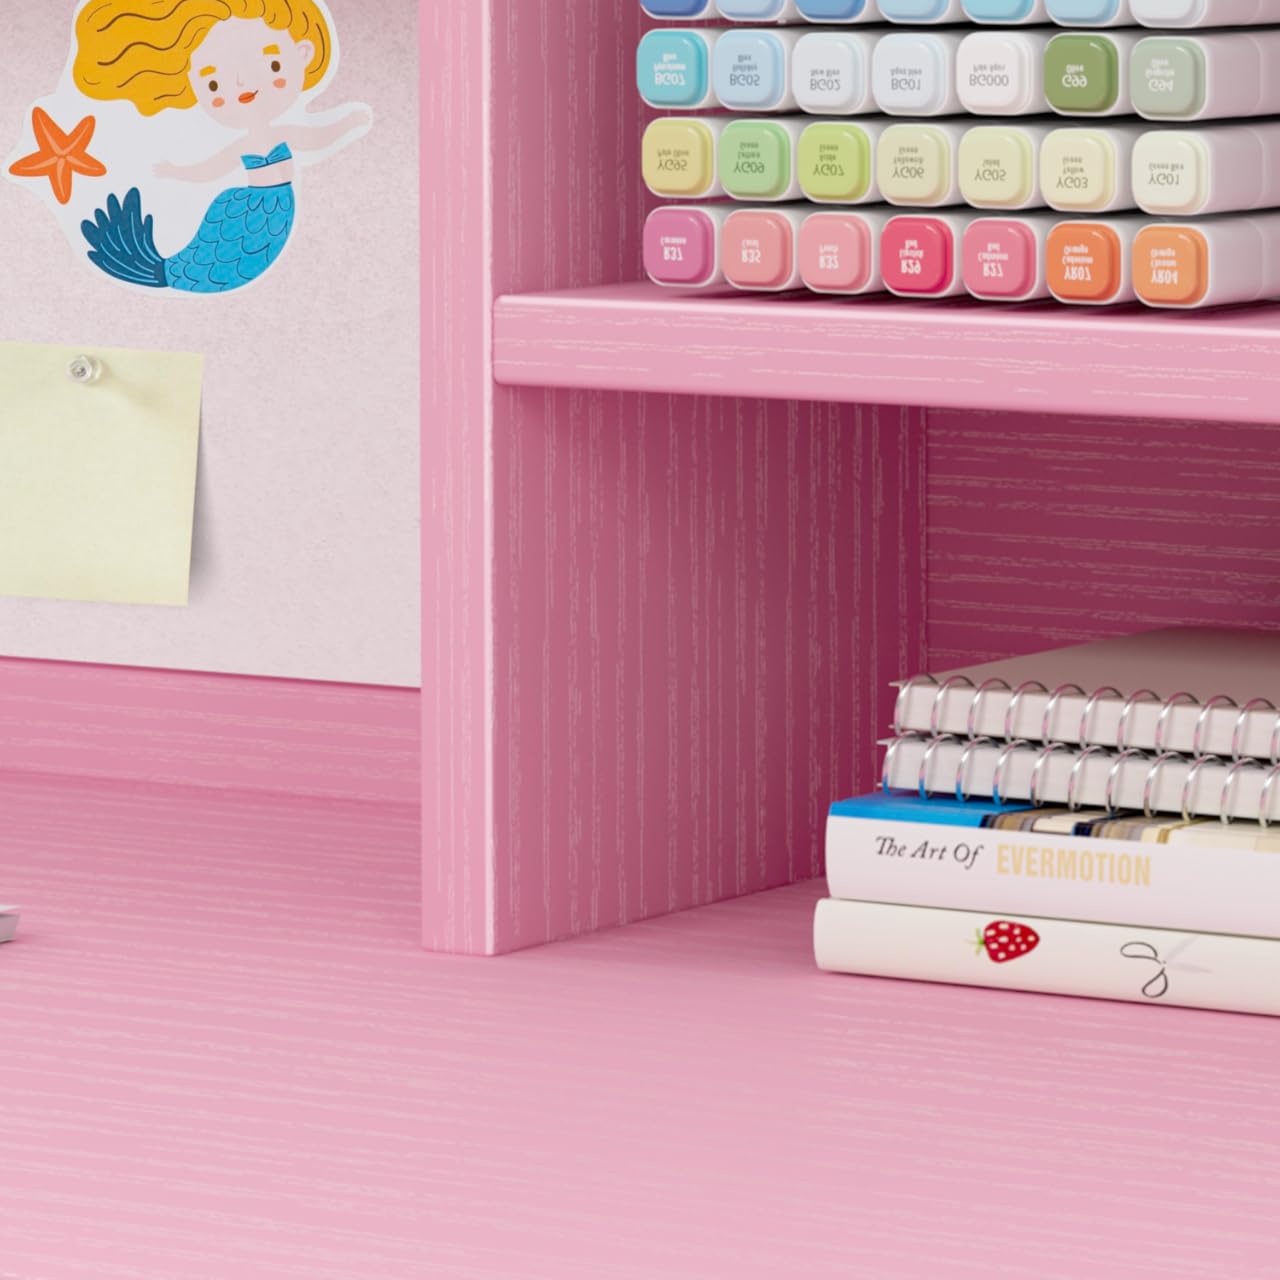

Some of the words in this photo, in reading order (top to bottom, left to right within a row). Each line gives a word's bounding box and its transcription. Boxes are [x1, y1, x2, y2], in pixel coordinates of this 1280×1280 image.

[874, 835, 908, 858] The
[910, 840, 947, 861] Art
[953, 841, 984, 869] Of
[996, 843, 1152, 888] EVERMOTION
